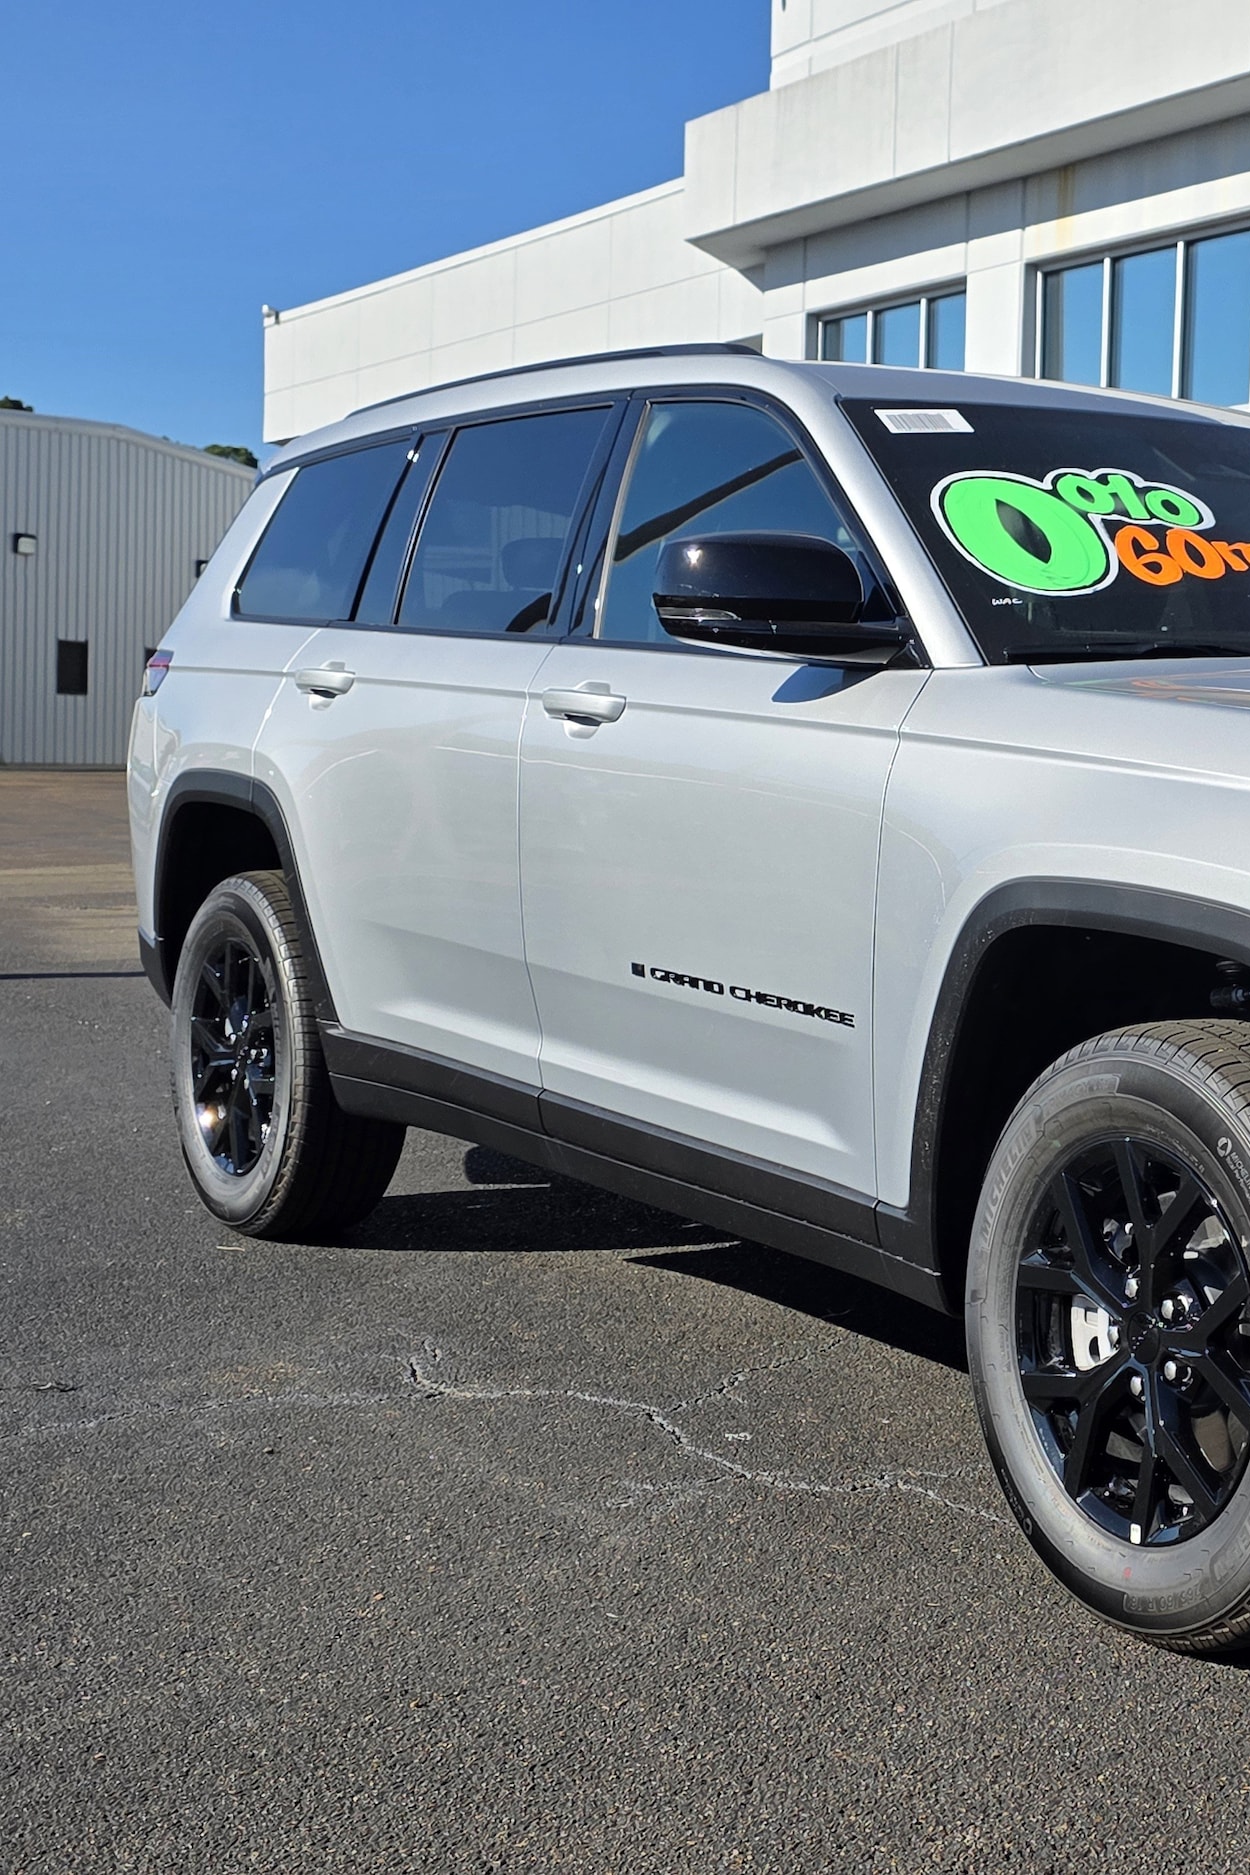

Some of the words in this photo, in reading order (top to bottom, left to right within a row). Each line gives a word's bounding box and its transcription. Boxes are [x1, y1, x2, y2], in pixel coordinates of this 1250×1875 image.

[649, 967, 724, 996] GRAND
[729, 986, 855, 1028] CHEROKEE
[979, 1118, 1034, 1244] MICHELIN
